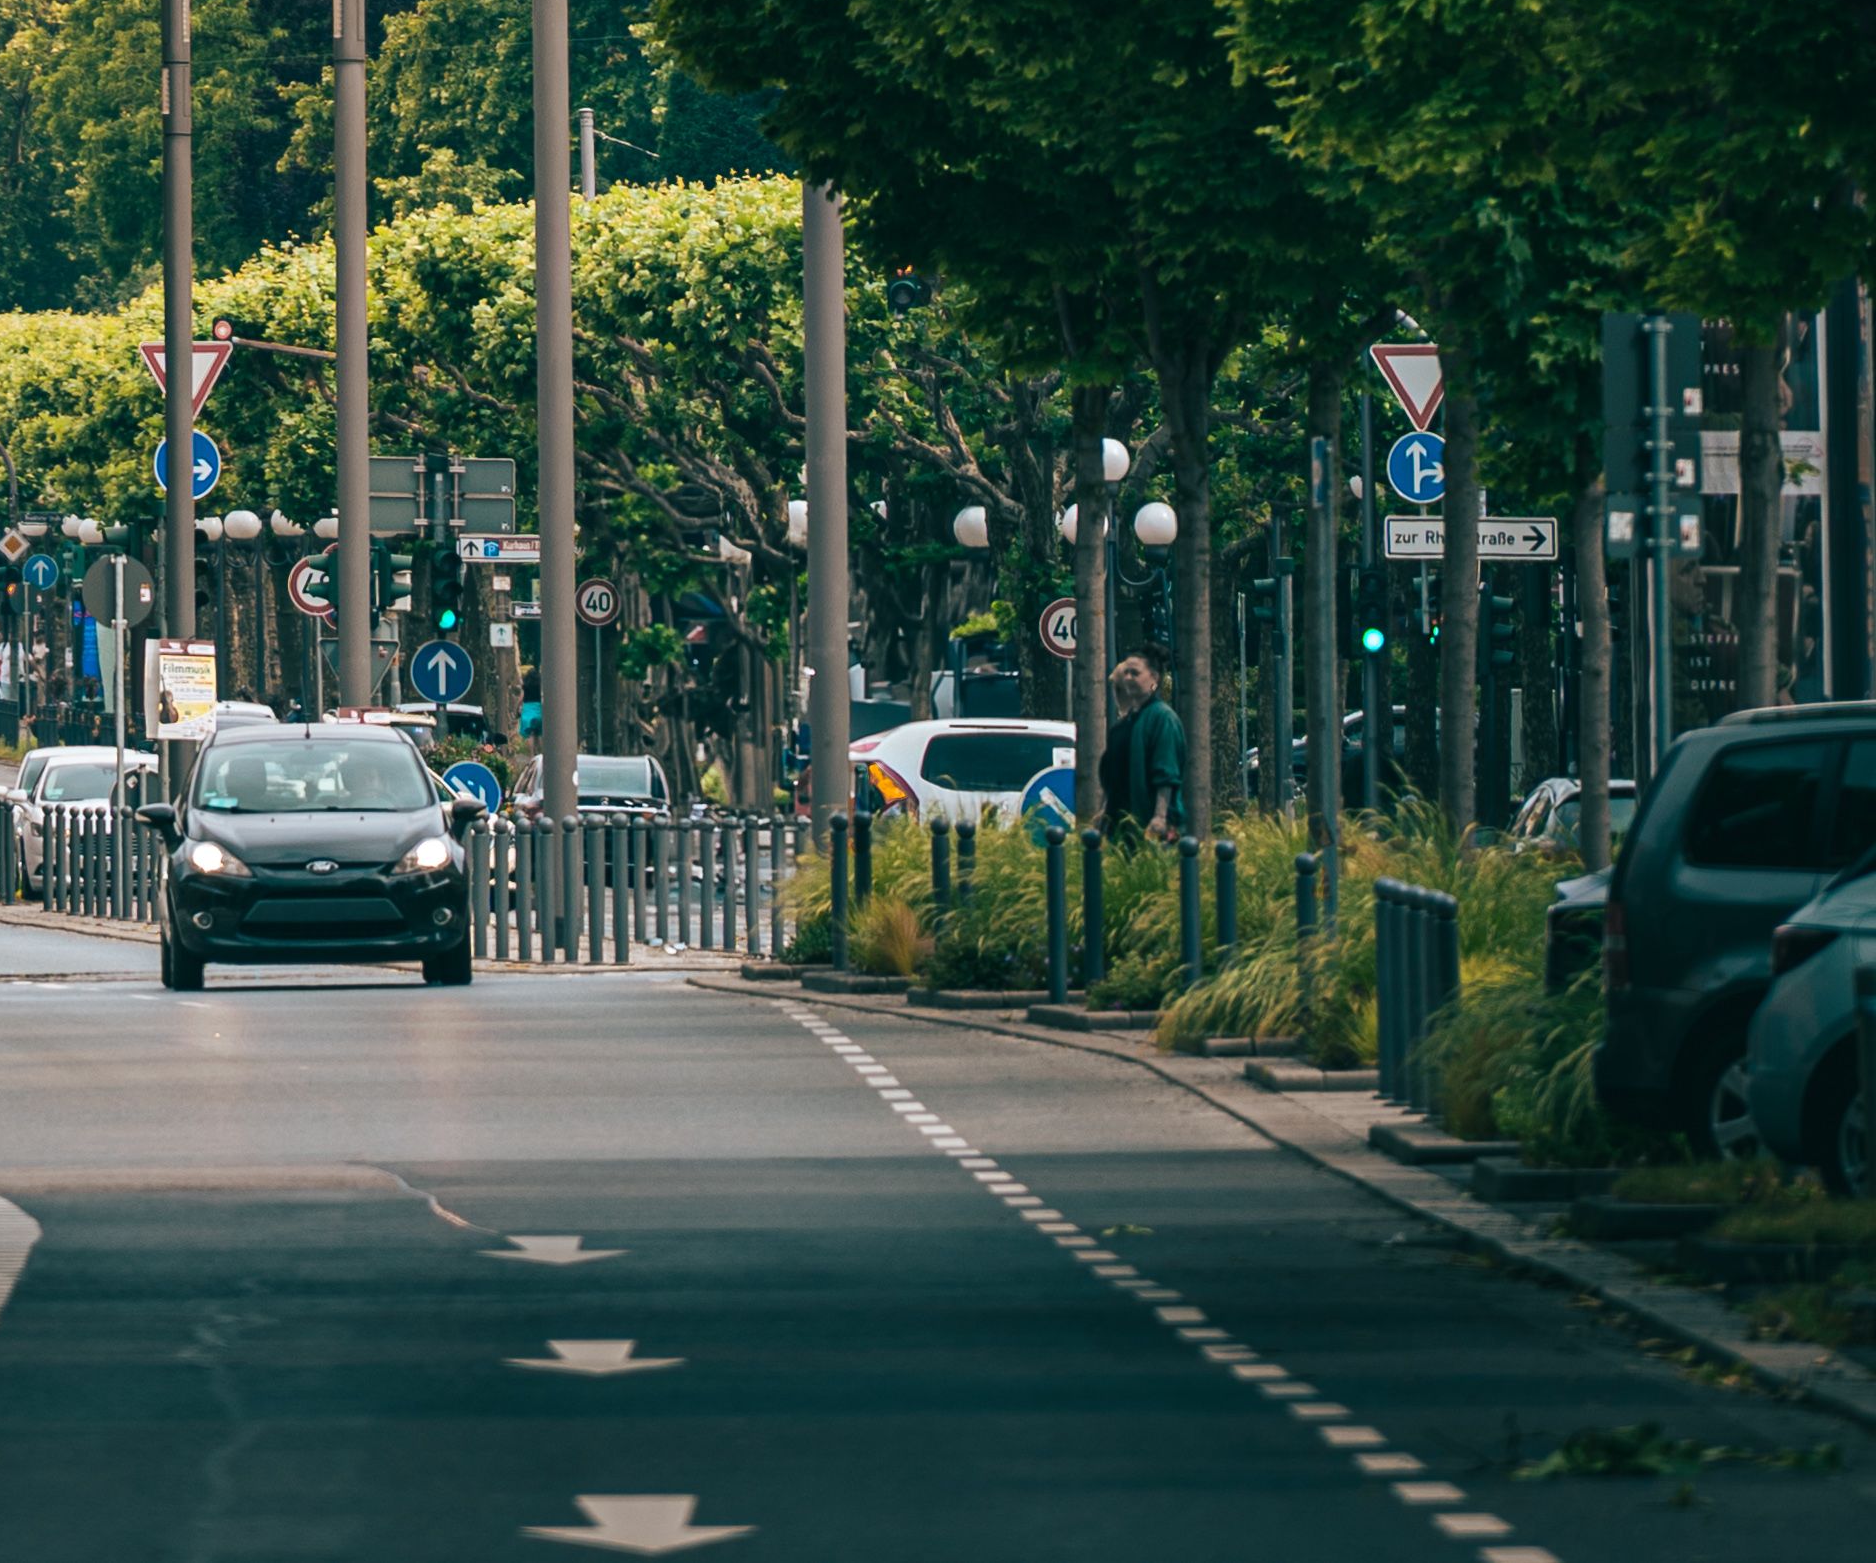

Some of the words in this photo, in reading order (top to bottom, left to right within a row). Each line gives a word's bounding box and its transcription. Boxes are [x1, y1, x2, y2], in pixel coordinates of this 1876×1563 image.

[1704, 363, 1740, 374] PRES
[1394, 533, 1419, 544] zur
[1425, 530, 1515, 545] Rhtraße
[585, 591, 611, 613] 40
[1690, 633, 1739, 645] STEFFE
[1689, 656, 1712, 667] IST
[163, 663, 211, 674] Filmmusik
[1690, 680, 1737, 691] DEPRE
